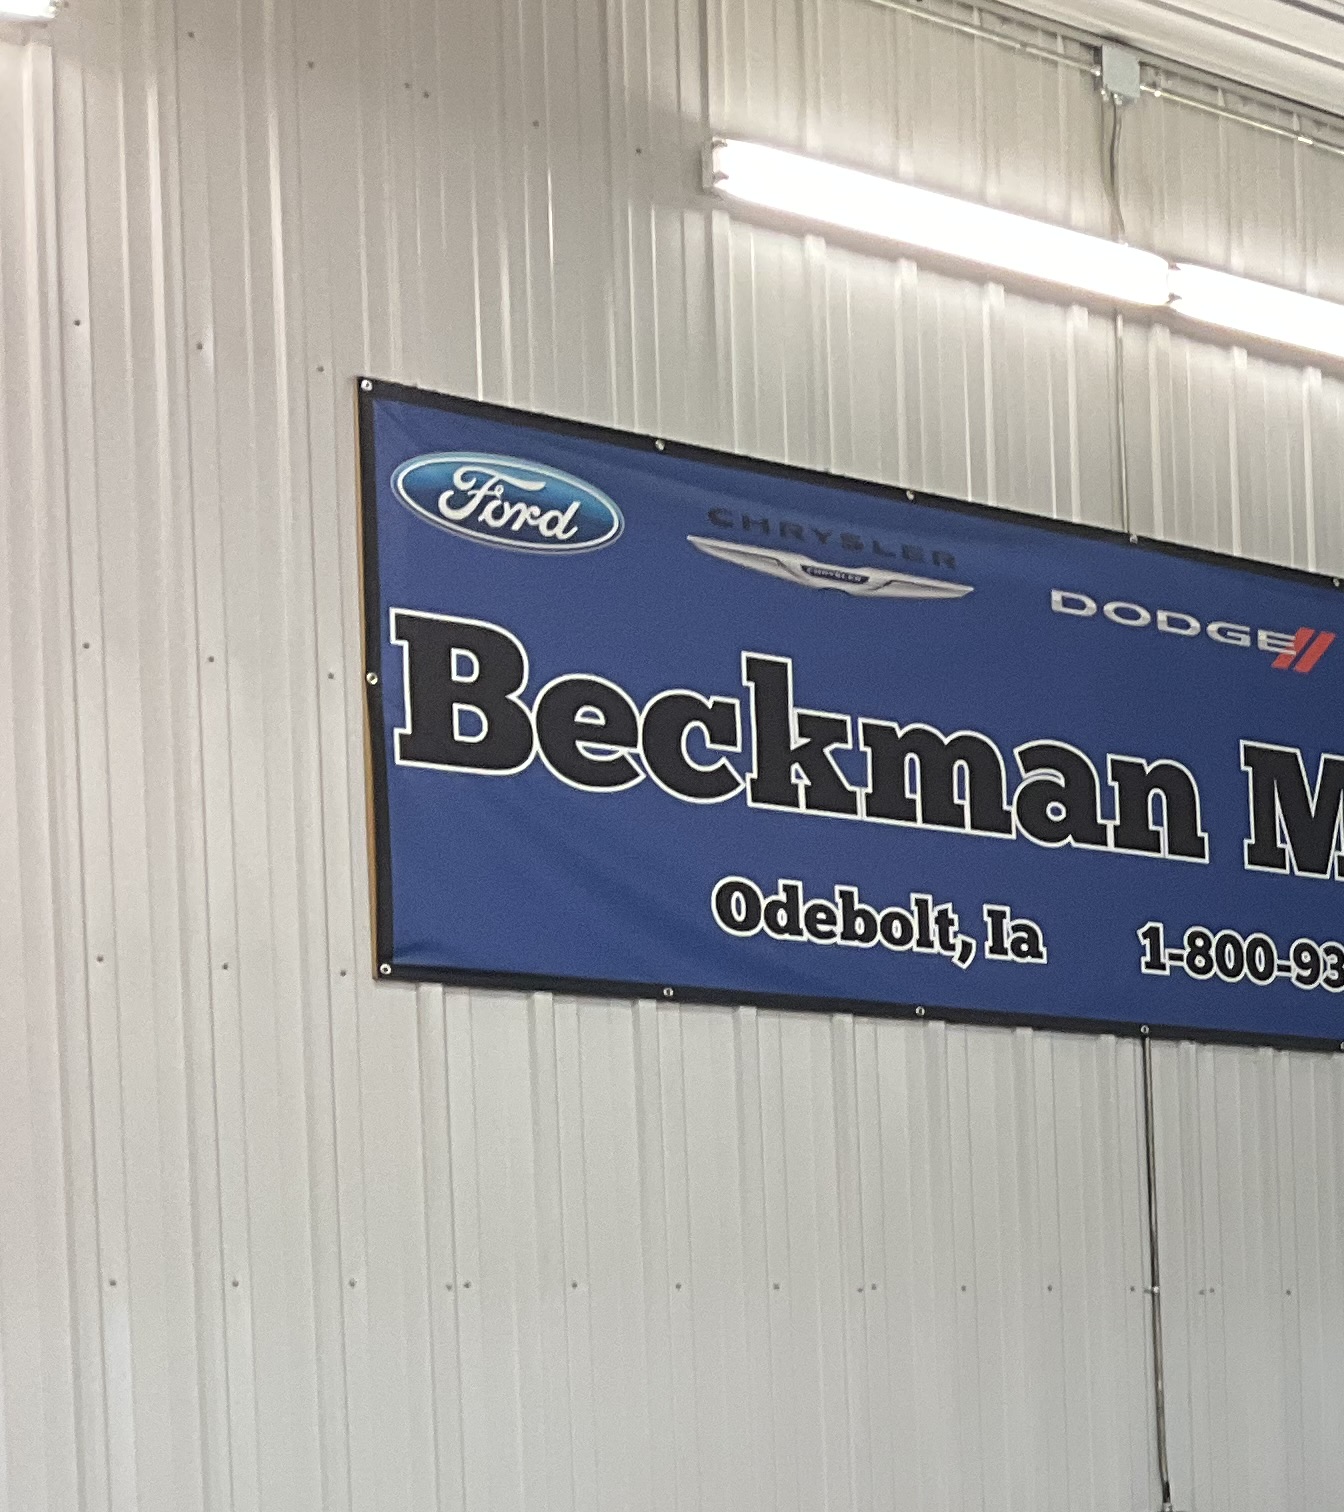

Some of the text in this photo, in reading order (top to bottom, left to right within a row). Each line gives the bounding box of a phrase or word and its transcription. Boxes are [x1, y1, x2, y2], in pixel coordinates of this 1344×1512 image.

[438, 464, 581, 543] Ford
[707, 507, 957, 570] CHRYSLER
[1050, 588, 1298, 656] DODGE
[389, 606, 1210, 864] Beckman
[710, 875, 1047, 969] Odebolt, Ia
